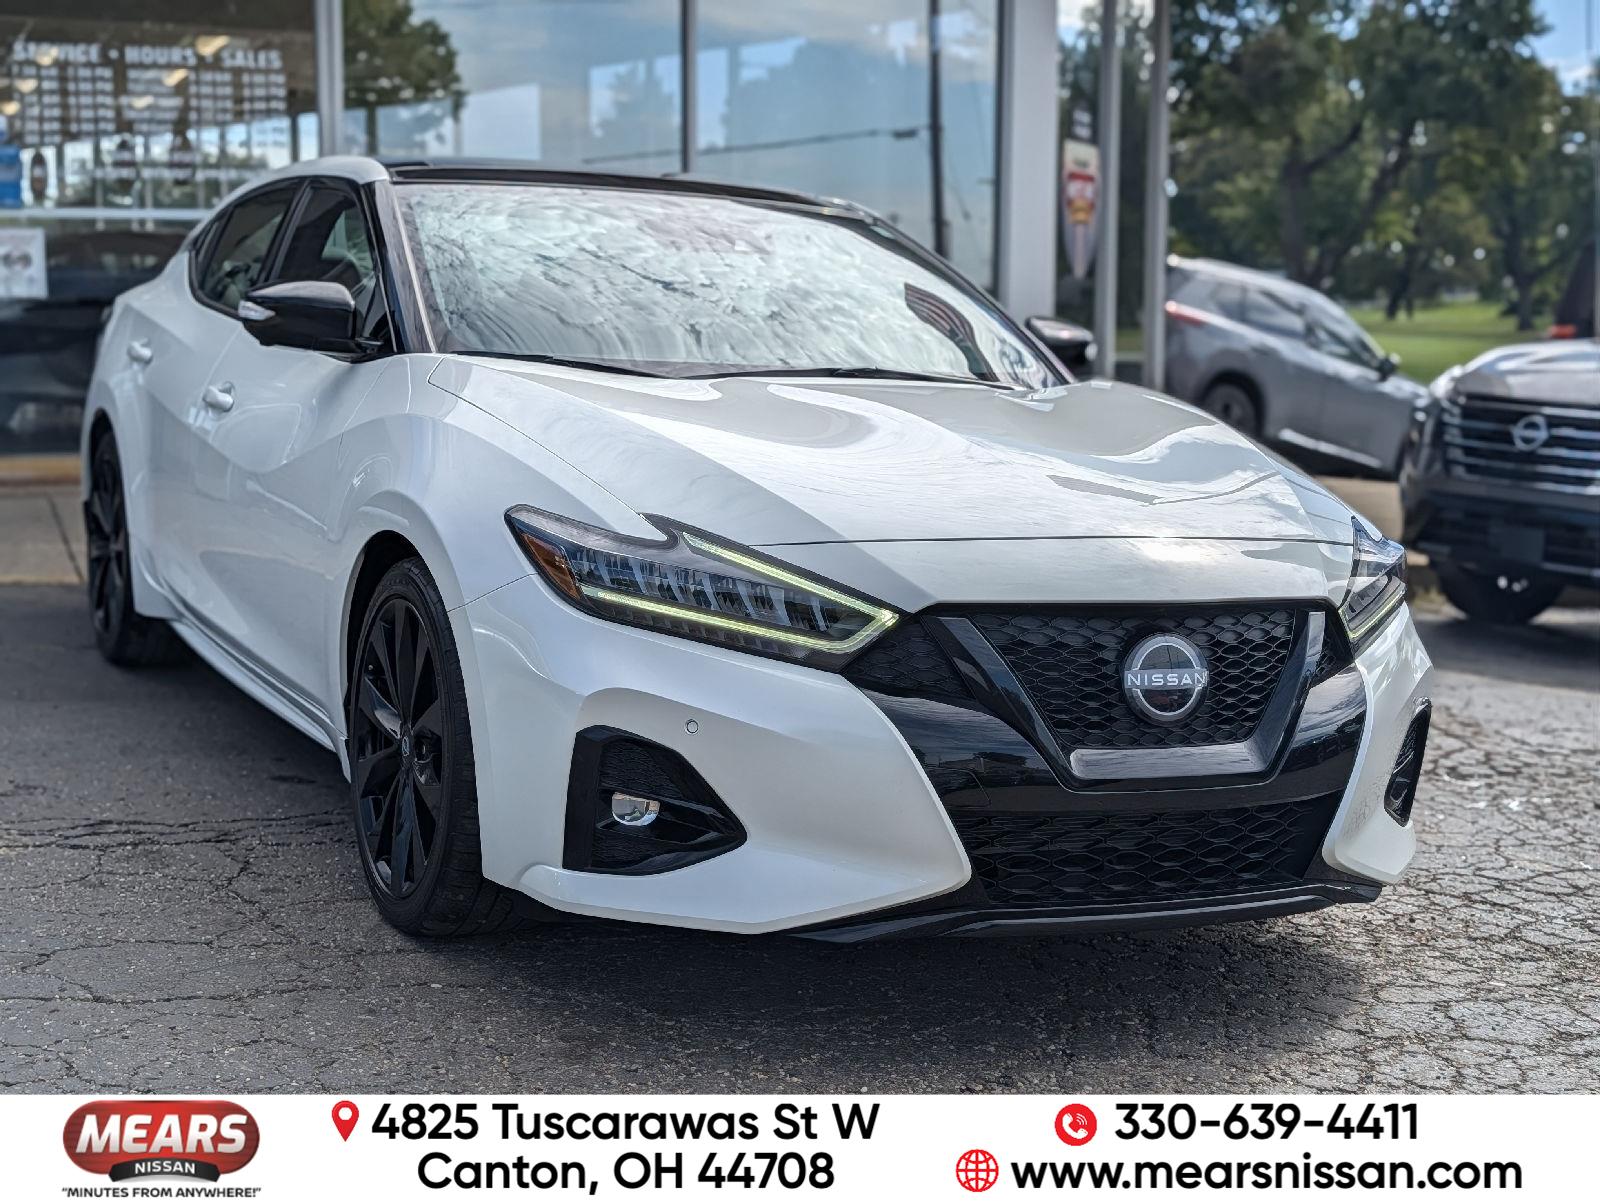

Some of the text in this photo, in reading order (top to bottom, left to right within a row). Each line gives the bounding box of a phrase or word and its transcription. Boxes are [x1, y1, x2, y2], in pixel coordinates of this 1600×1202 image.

[13, 41, 282, 69] SEVICE HOURS SALES
[1127, 672, 1207, 687] NISSAN
